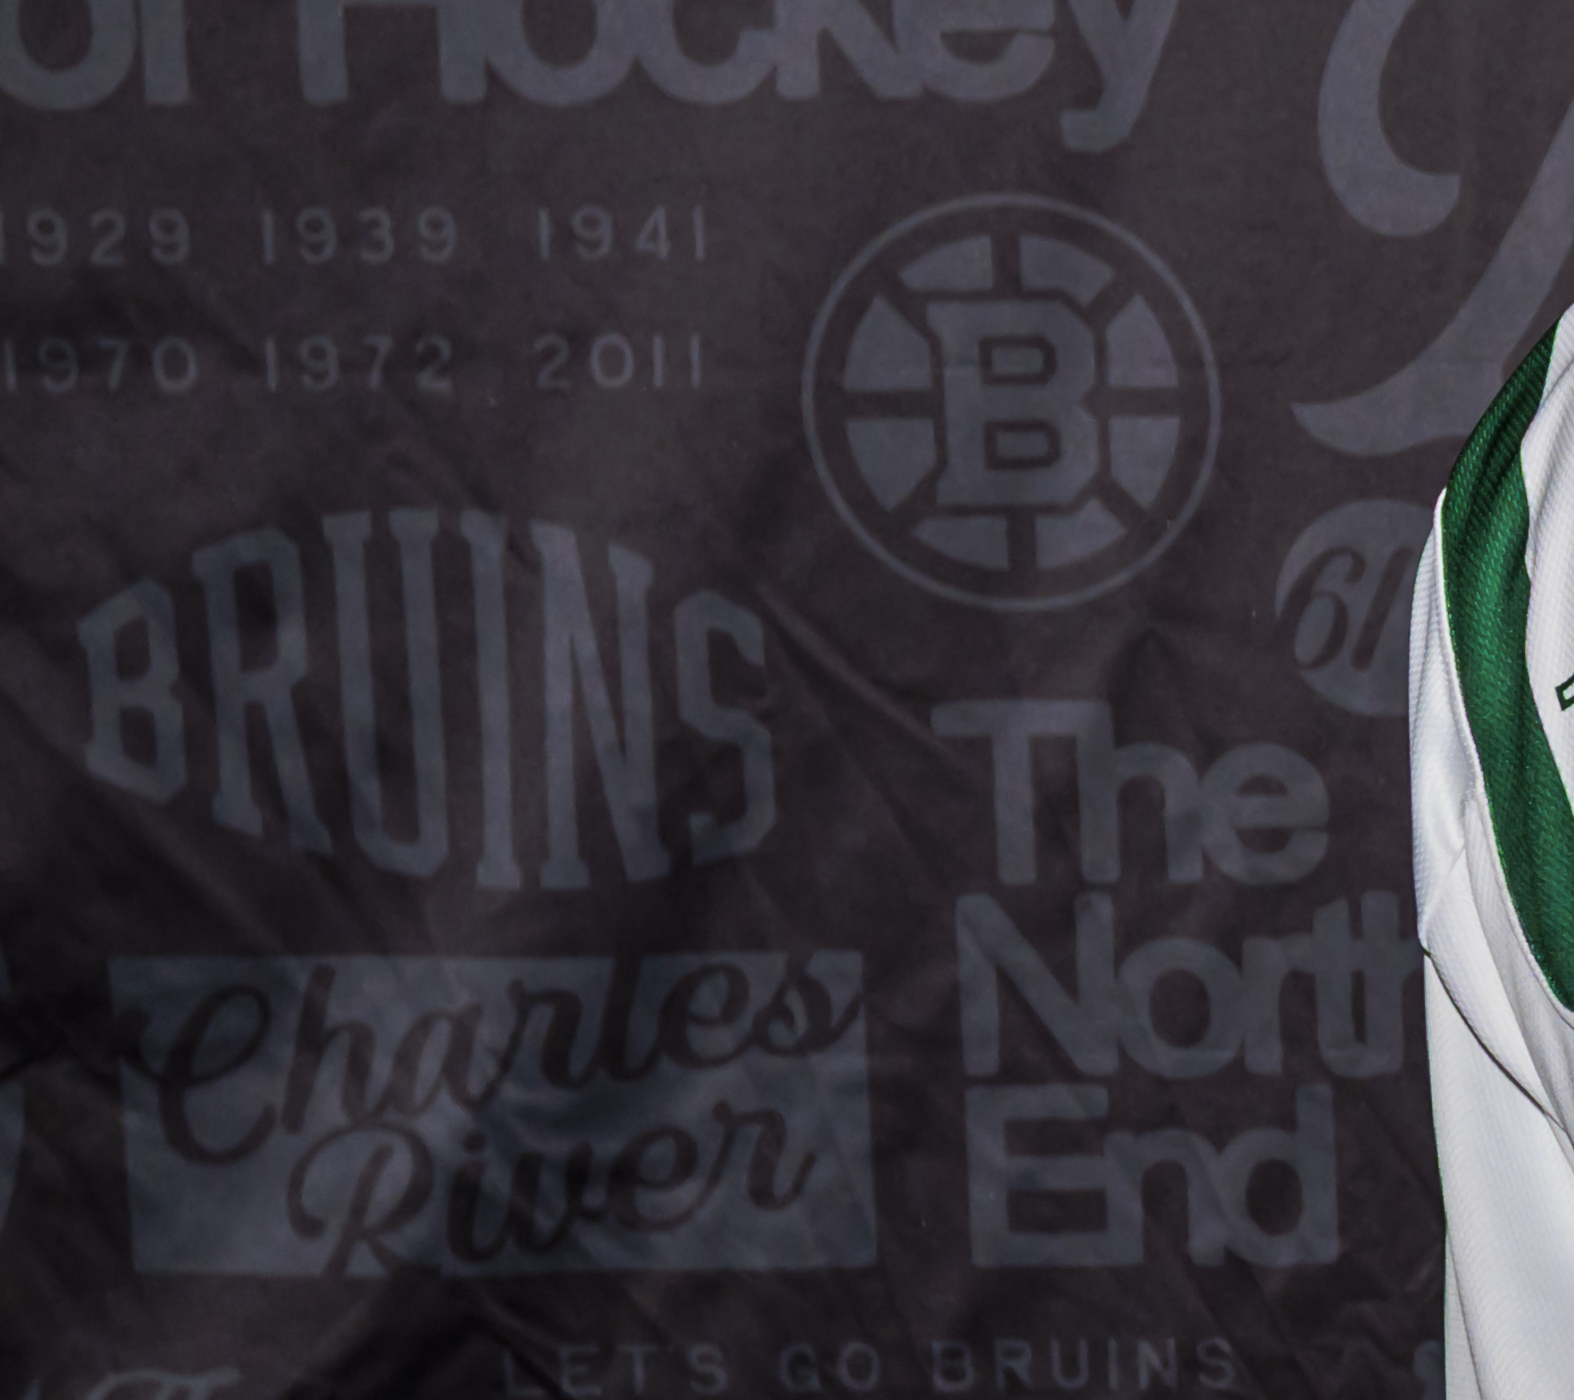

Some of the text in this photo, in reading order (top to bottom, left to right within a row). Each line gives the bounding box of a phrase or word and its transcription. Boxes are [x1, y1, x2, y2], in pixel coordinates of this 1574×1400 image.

[261, 205, 458, 266] 1939
[536, 204, 706, 265] 1941
[3, 330, 704, 395] 1970 1972 2011
[80, 507, 778, 892] BRUINS
[934, 698, 1331, 888] The
[115, 950, 868, 1166] Charles
[286, 1099, 816, 1278] River
[963, 1082, 1341, 1270] End
[501, 1336, 1241, 1400] LET'S GO BRUINS
